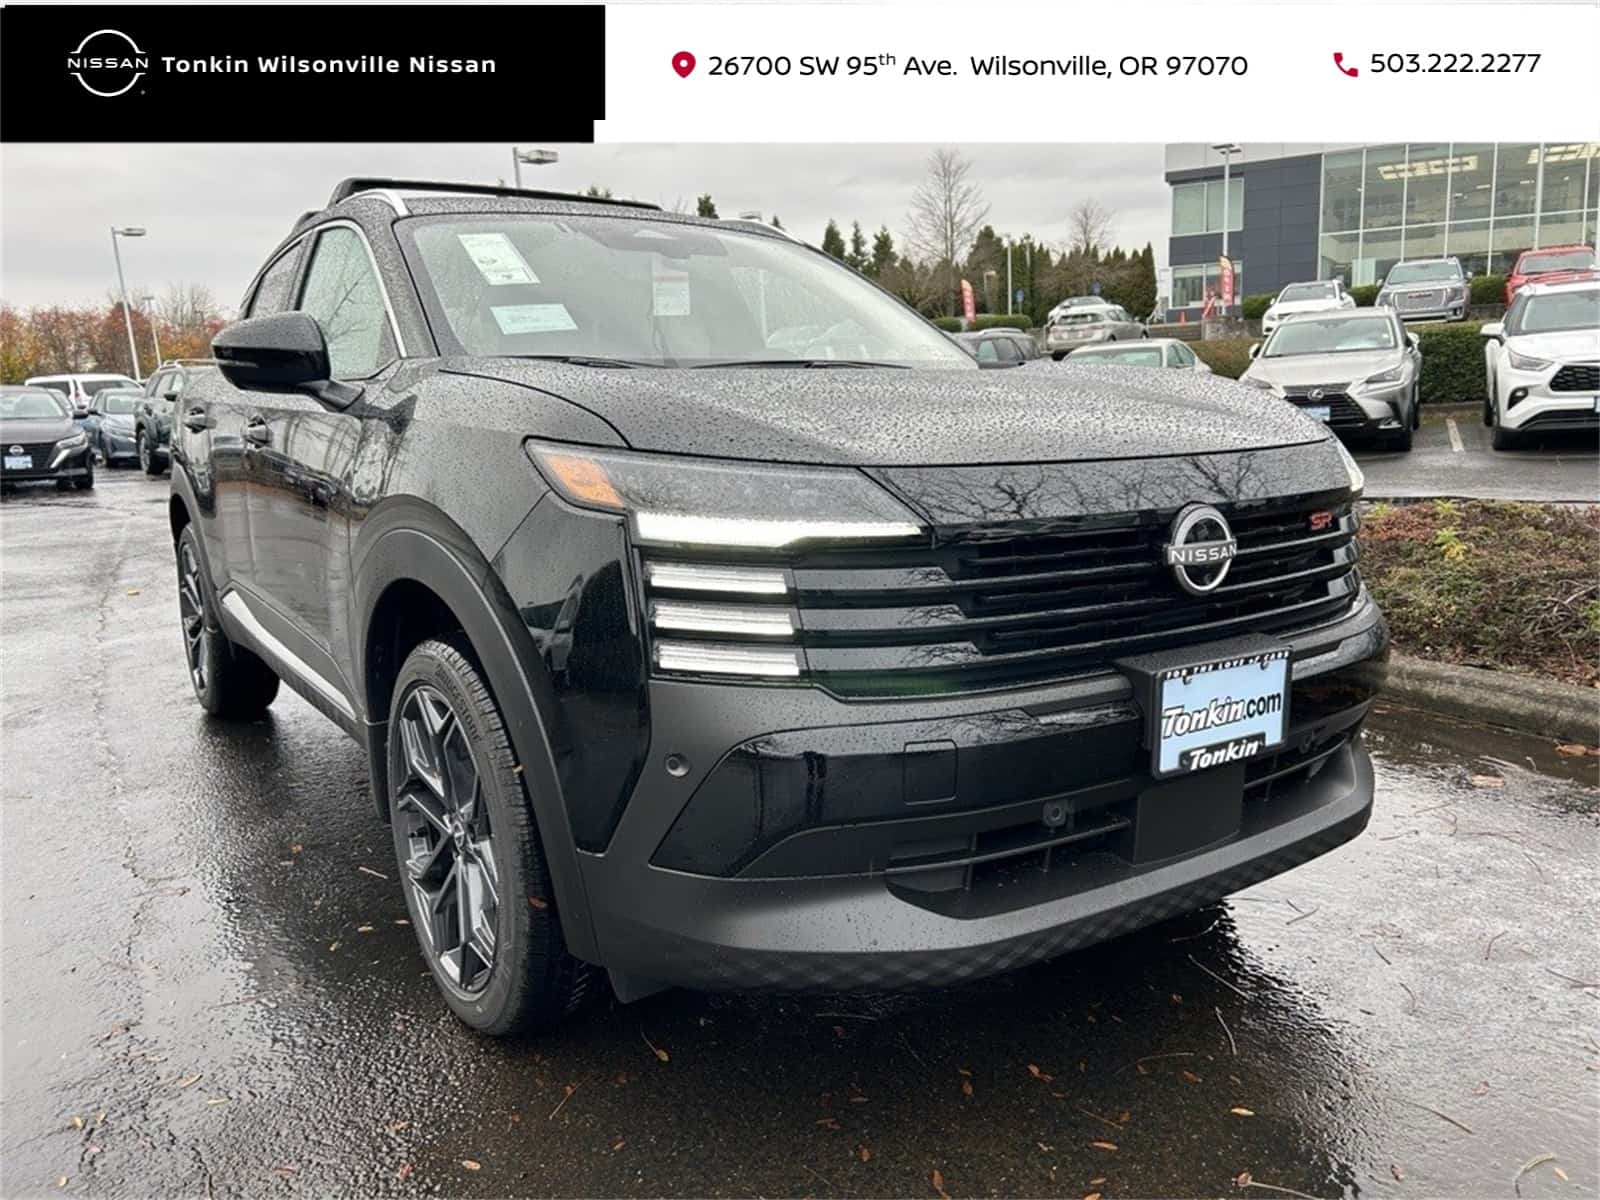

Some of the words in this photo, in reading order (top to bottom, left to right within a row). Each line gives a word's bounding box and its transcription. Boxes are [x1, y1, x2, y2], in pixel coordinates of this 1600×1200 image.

[1309, 511, 1333, 531] SR
[1170, 543, 1237, 563] NISSAN
[1162, 692, 1281, 739] Tonkin.com
[1189, 739, 1260, 770] Tonkin
